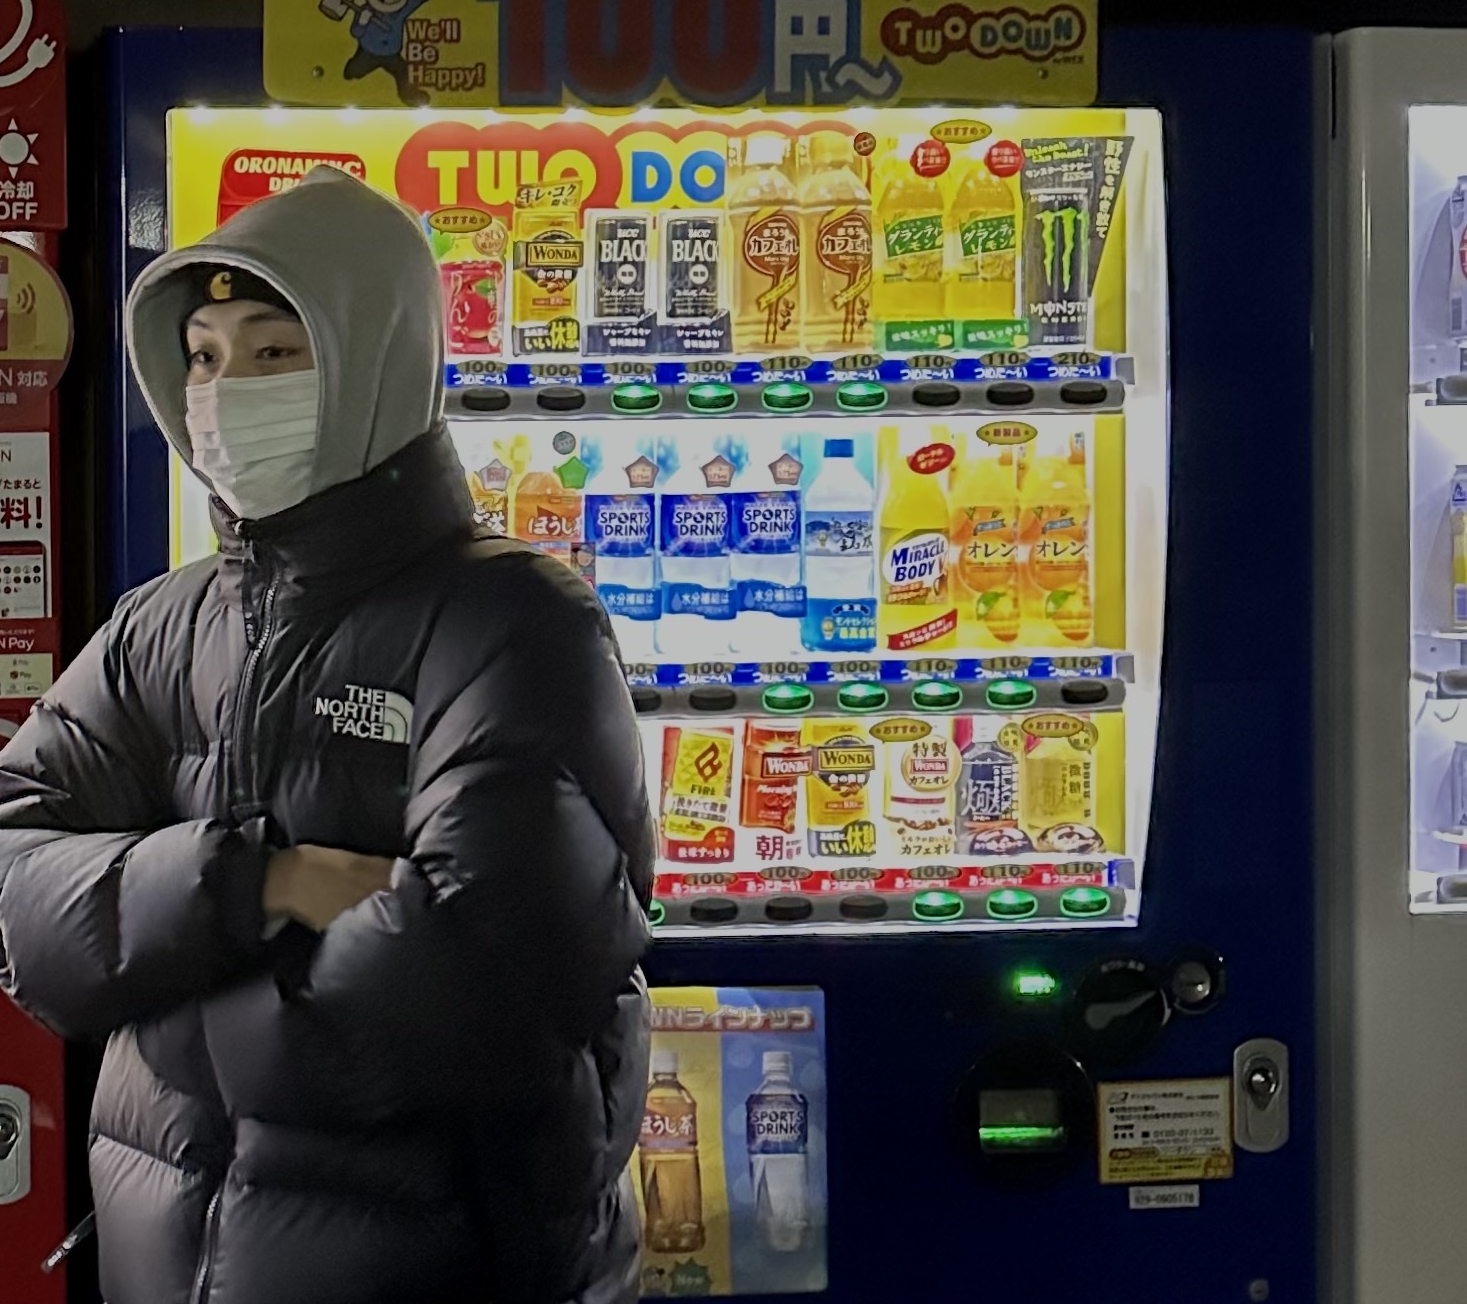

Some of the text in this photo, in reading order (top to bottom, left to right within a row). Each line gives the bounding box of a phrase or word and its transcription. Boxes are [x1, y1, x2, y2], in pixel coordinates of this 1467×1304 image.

[406, 18, 460, 43] We'll
[893, 14, 1075, 54] TWO DOWN
[407, 41, 437, 65] Be
[407, 63, 485, 93] Happy!
[630, 149, 726, 203] DO
[533, 244, 580, 262] WONDA
[601, 239, 648, 263] BLACK
[672, 239, 720, 263] BLACK
[16, 370, 49, 388] 対応
[599, 511, 650, 525] SPORTS
[675, 511, 727, 525] SPORTS
[744, 508, 796, 522] SPORTS
[604, 524, 648, 537] DRINK
[679, 524, 724, 537] DRINK
[749, 520, 793, 533] DRINK
[891, 543, 945, 568] MIRACLE
[894, 562, 936, 583] BODY
[8, 637, 35, 652] Pay
[345, 684, 386, 705] THE
[315, 696, 384, 722] NORTH
[332, 717, 383, 739] FACE
[823, 751, 873, 766] WONDA
[912, 742, 948, 758] 特製
[765, 758, 810, 777] WONDA
[909, 775, 949, 785] カフェオレ
[755, 835, 783, 861] 朝
[900, 843, 951, 856] カフェオレ
[651, 1005, 812, 1030] WNラインナップ
[752, 1110, 804, 1124] SPORTS
[757, 1122, 799, 1136] DRINK
